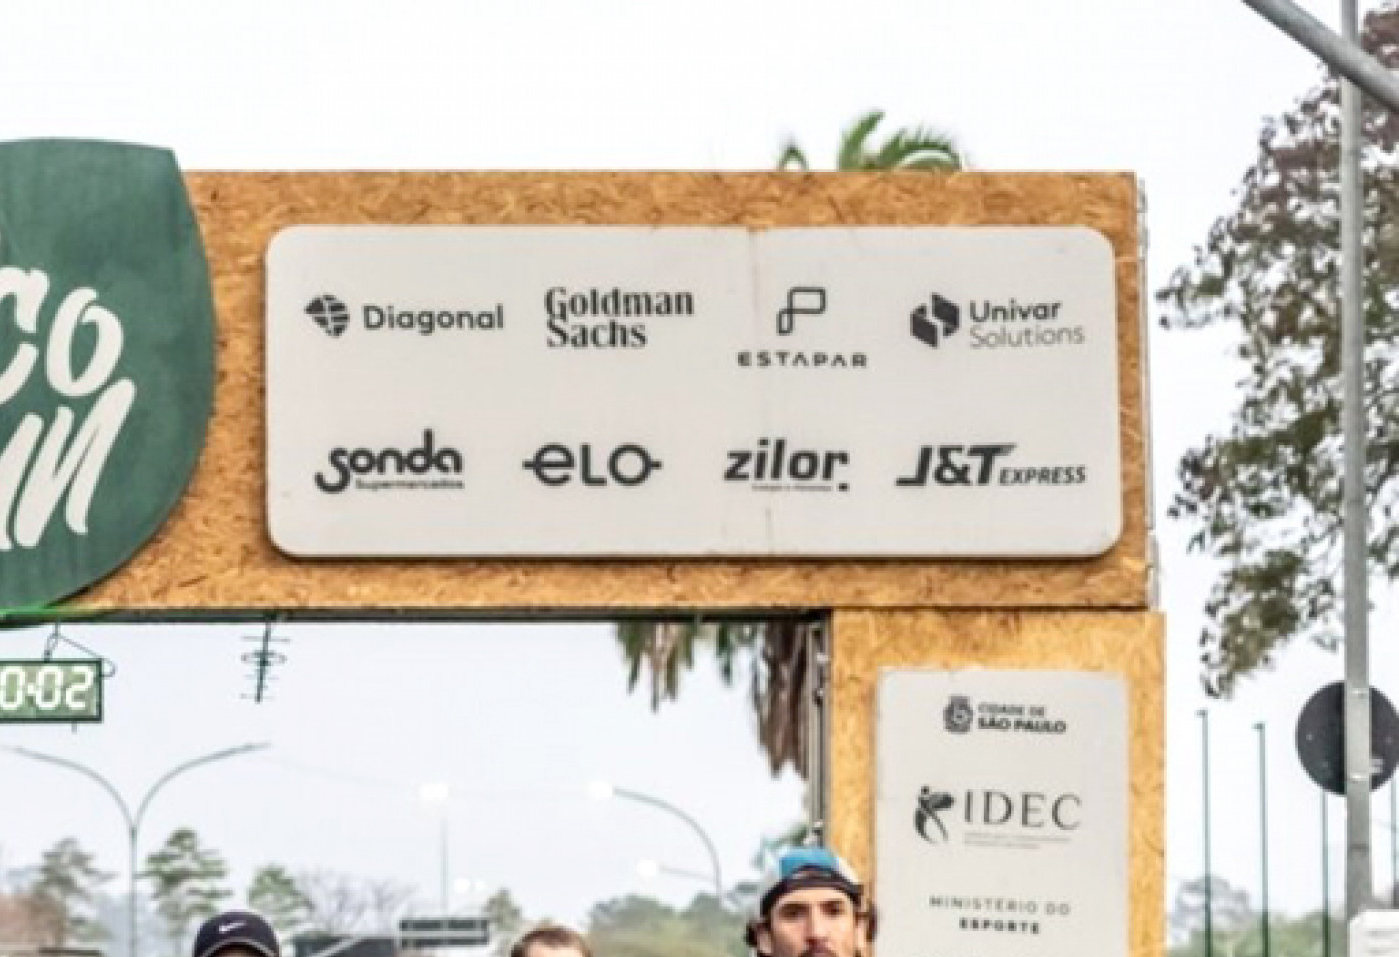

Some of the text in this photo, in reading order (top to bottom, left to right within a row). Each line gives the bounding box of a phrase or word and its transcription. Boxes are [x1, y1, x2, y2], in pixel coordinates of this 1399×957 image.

[544, 286, 694, 321] Goldman
[970, 298, 1061, 323] Univar
[363, 303, 504, 336] Diagonal
[546, 319, 648, 348] Sachs
[970, 322, 1085, 349] Solutions
[738, 350, 868, 368] ESTAPAR
[895, 443, 1086, 487] J&T EXPRESS
[1014, 719, 1067, 734] PAULO
[964, 788, 1081, 830] IDEC
[1046, 901, 1071, 915] DO
[959, 917, 1040, 934] ESPORTE
